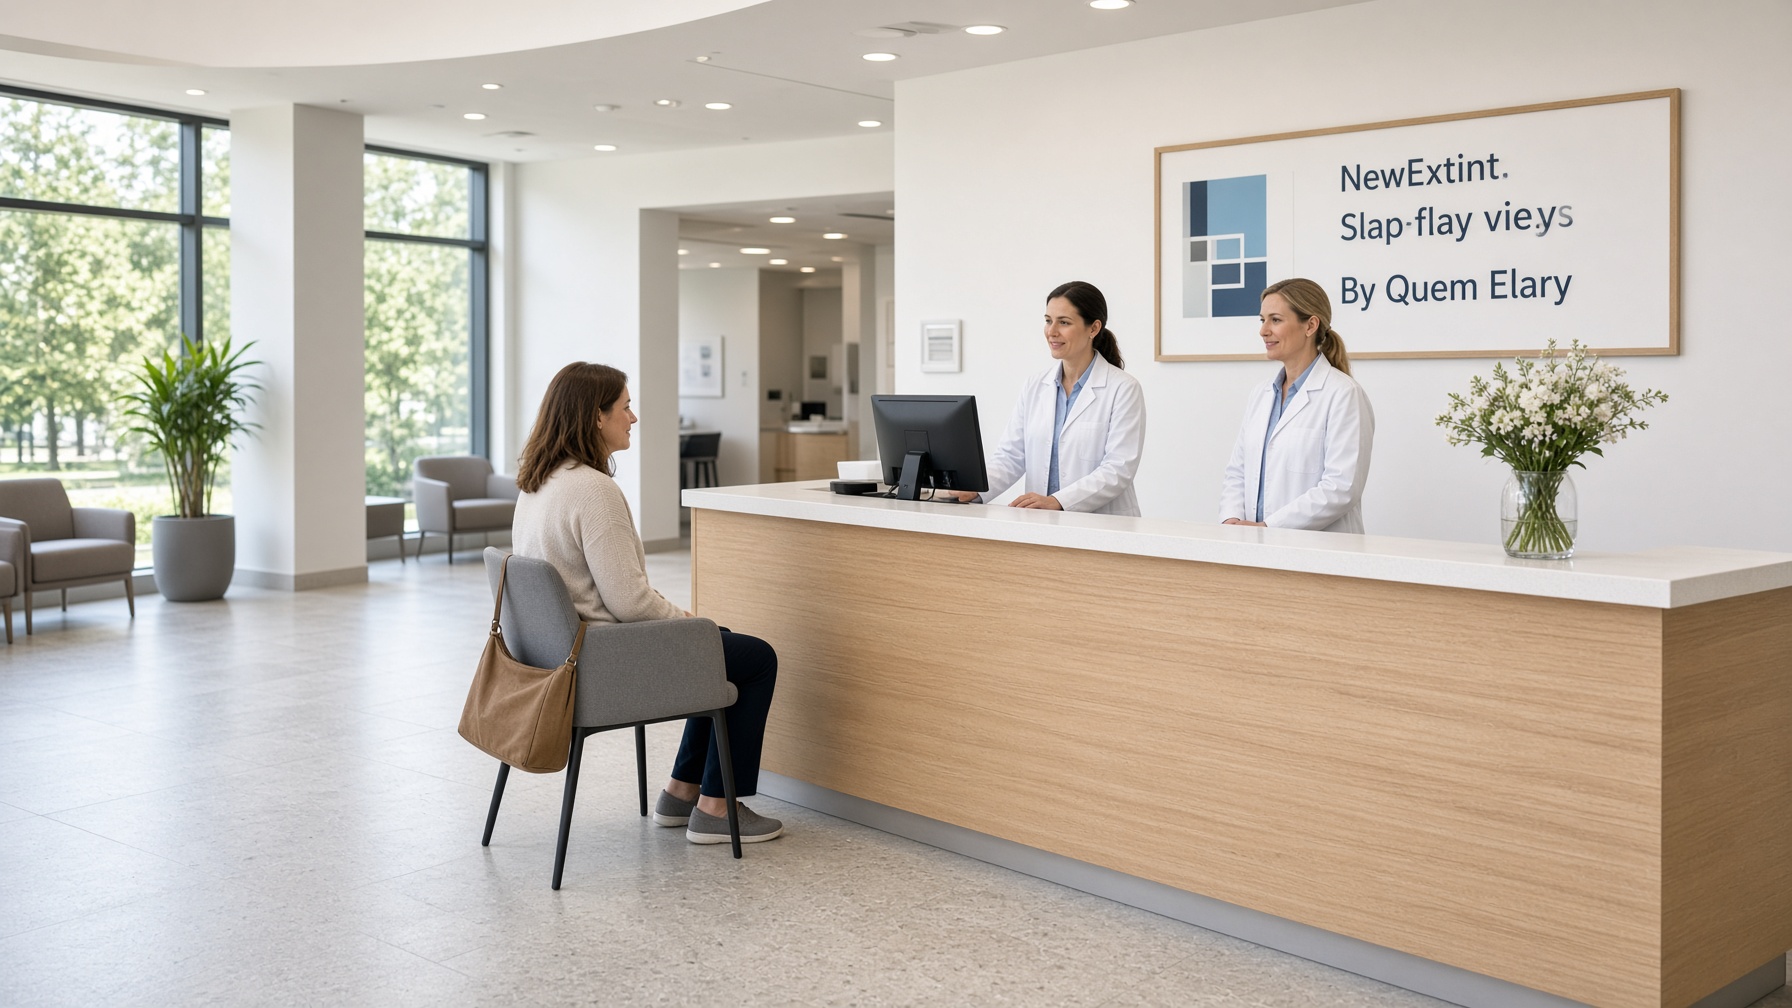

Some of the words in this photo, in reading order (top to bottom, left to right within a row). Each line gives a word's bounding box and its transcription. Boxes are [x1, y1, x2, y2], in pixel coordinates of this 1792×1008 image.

[1341, 276, 1376, 311] By
[1386, 273, 1478, 306] Quem
[1490, 268, 1573, 305] Elary
